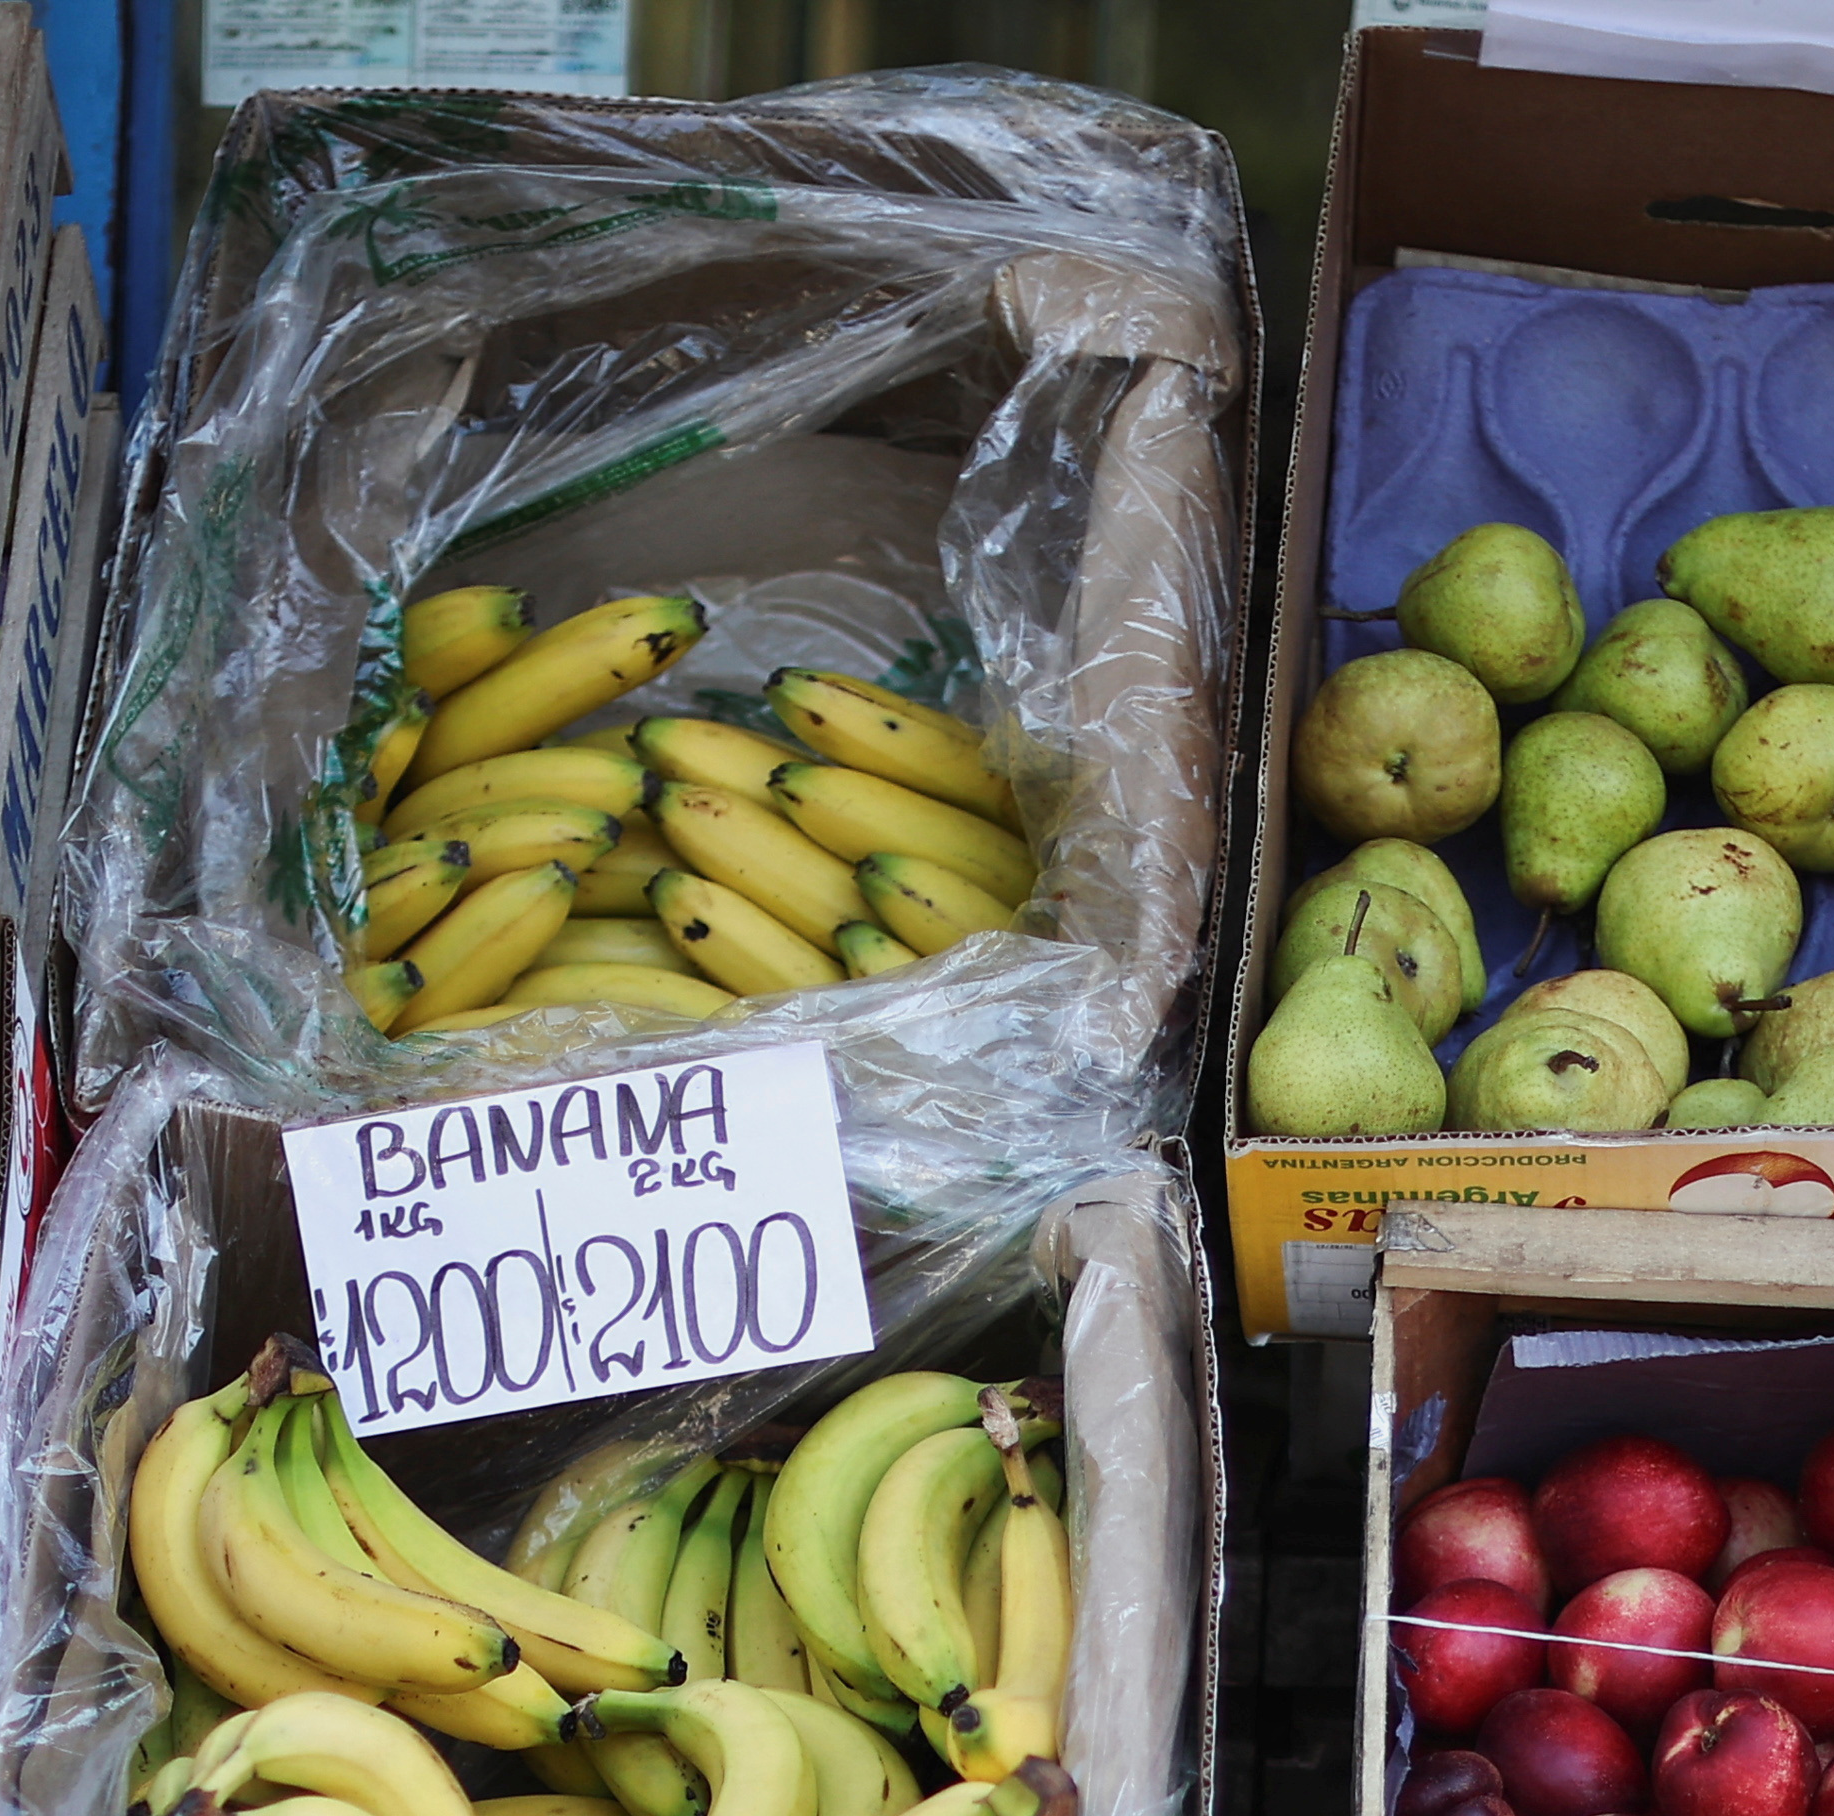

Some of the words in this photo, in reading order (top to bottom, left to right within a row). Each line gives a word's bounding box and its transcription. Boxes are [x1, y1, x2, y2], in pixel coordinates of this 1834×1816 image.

[1, 303, 89, 907] MARCELO
[355, 1064, 729, 1200] BANANA
[1262, 1157, 1409, 1171] ARGENTINA
[1416, 1152, 1588, 1168] PRODUCCION
